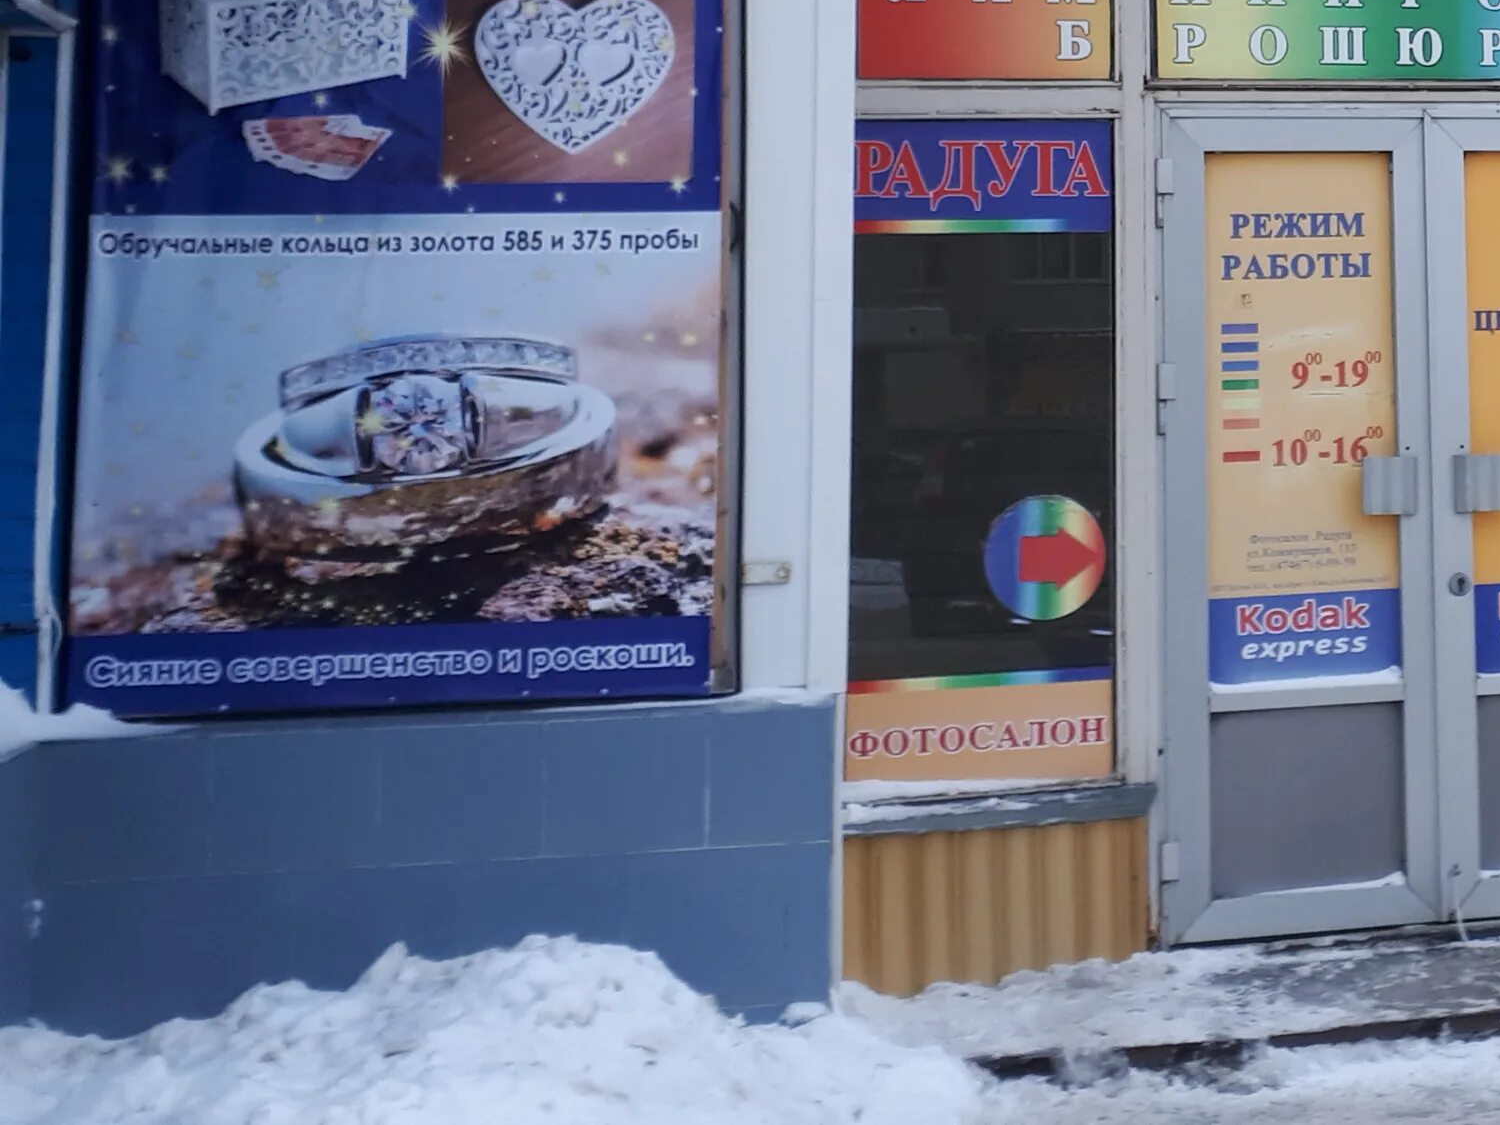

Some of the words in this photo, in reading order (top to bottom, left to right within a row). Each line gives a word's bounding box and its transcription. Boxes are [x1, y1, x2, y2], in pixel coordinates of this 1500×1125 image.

[854, 139, 1111, 212] РАДУГА
[99, 231, 274, 259] Обручальные
[281, 234, 370, 256] кольца
[377, 234, 403, 253] из
[409, 232, 495, 253] золота
[502, 229, 544, 252] 585
[551, 234, 565, 251] и
[571, 228, 613, 252] 375
[619, 227, 700, 255] пробы
[1229, 211, 1366, 239] РЕЖИМ
[1221, 252, 1372, 281] РАБОТЫ
[1236, 597, 1371, 637] Kodak
[85, 655, 222, 688] Сияние
[227, 650, 493, 687] совершенство
[497, 649, 522, 675] и
[525, 641, 697, 680] роскоши.
[1240, 634, 1369, 662] express
[848, 716, 1108, 758] ФОТОСАЛОН
